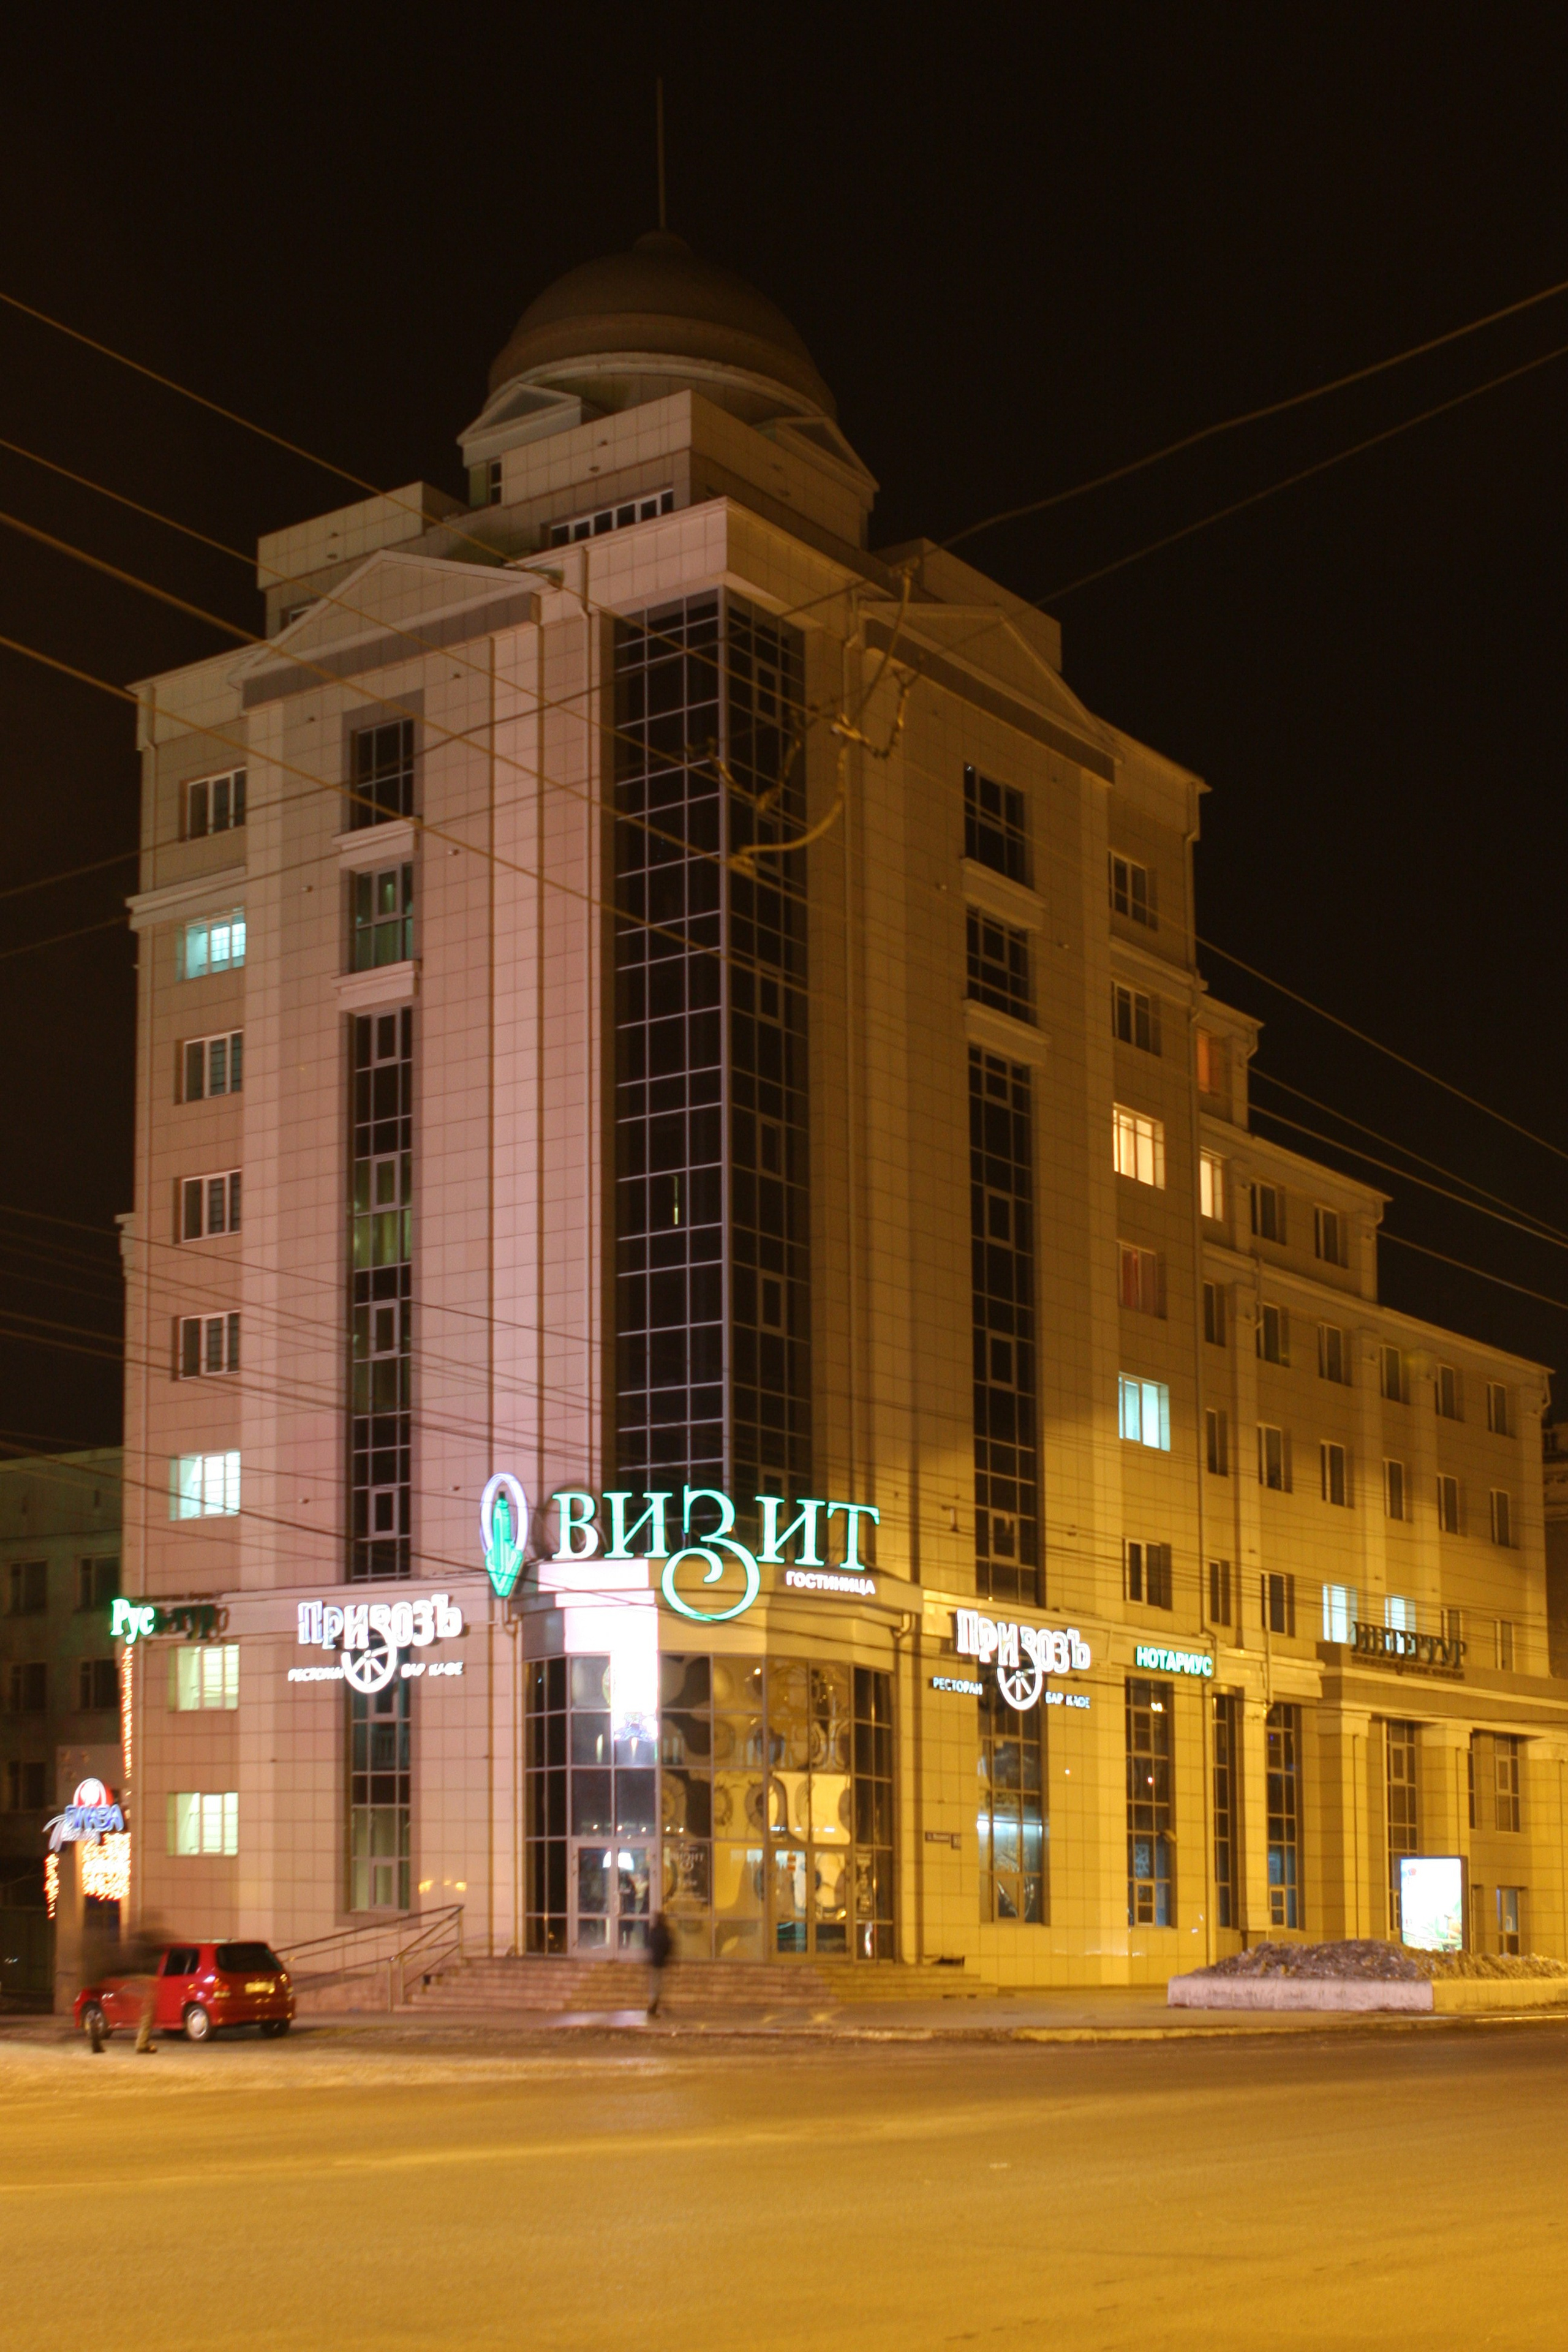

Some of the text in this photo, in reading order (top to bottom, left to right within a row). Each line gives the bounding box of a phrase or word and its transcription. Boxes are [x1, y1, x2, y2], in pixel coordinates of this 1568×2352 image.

[551, 1485, 880, 1621] ВИЗИТ
[786, 1570, 876, 1596] ГОСТИНИЦА
[1136, 1646, 1212, 1676] НОТАРИУС
[933, 1676, 1091, 1709] РЕСТОРАН БАР КАФЕ
